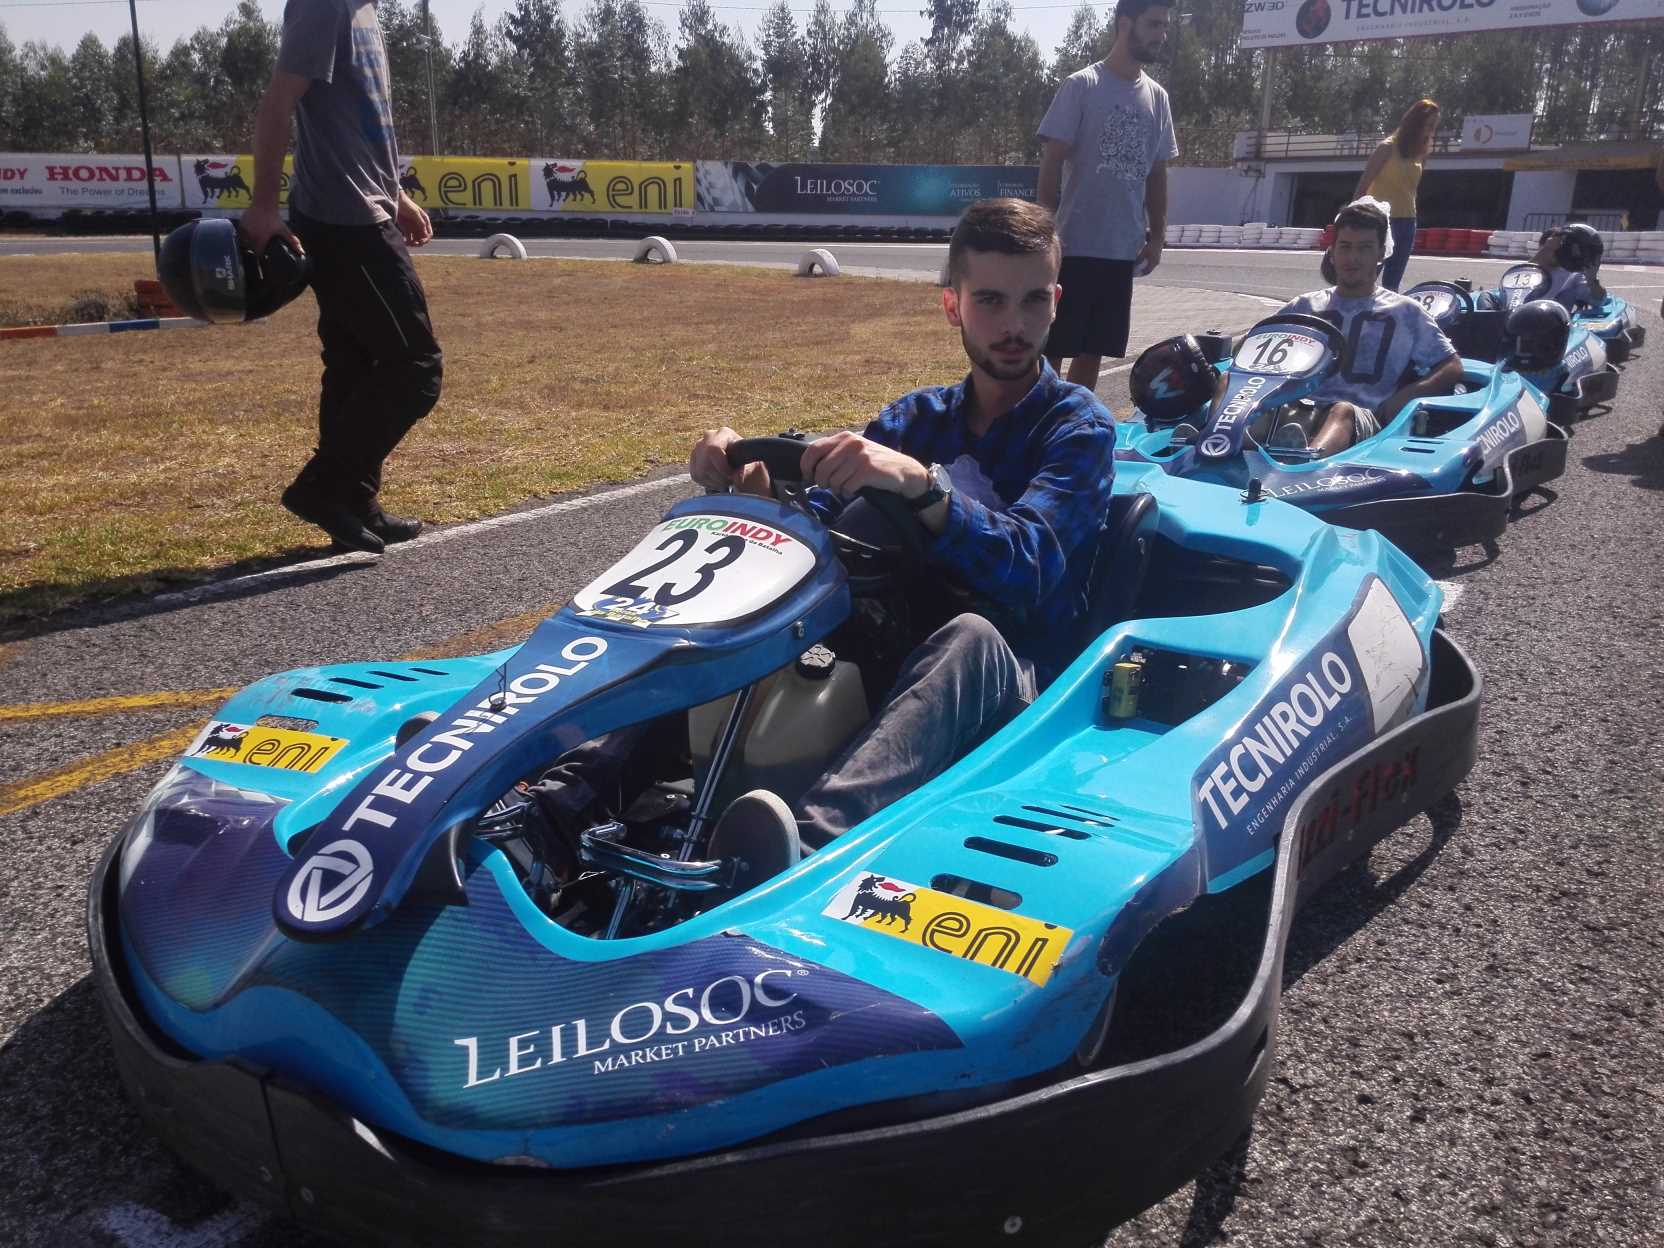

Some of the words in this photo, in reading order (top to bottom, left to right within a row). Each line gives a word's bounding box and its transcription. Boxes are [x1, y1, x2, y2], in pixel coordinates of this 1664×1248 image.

[45, 165, 173, 182] HONDA
[59, 186, 79, 196] The
[81, 187, 113, 196] Power
[114, 187, 126, 196] of
[127, 187, 166, 197] Dreas
[438, 160, 520, 208] eni
[606, 164, 683, 210] eni
[794, 176, 878, 195] LEILOSOC
[1512, 273, 1532, 286] 13
[1255, 337, 1295, 366] 16
[1212, 376, 1266, 433] TECNIROLO
[661, 518, 794, 546] EUROINDY
[600, 528, 746, 607] 23
[243, 737, 341, 773] eni
[342, 635, 609, 832] TECNIROLO
[1198, 651, 1353, 831] TECNIROLO
[1246, 778, 1296, 836] ENGENHARIA
[921, 912, 1058, 980] eni
[453, 968, 800, 1089] LEILOSOC
[592, 1040, 688, 1075] MARKET
[692, 1008, 807, 1053] PARTNERS
